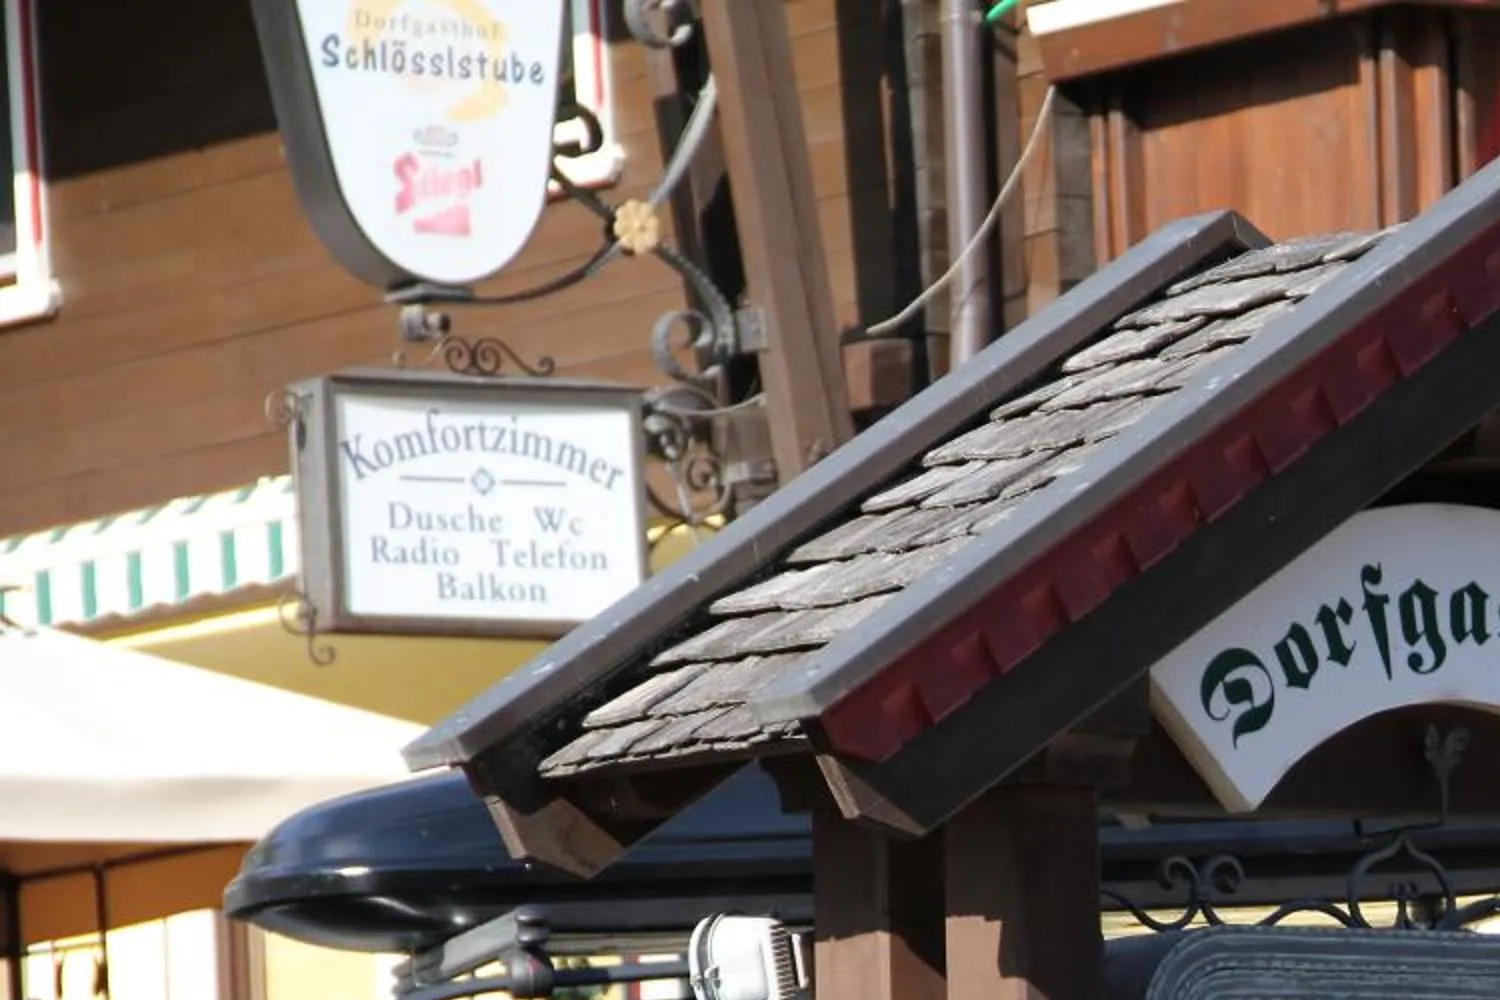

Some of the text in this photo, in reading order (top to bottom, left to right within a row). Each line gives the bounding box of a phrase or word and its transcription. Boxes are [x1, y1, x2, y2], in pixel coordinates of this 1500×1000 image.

[321, 33, 547, 85] Schlösslstube
[340, 407, 624, 491] Komfortzimmer
[388, 500, 504, 534] Dusche
[370, 535, 608, 571] Radio Telefon
[436, 572, 548, 602] Balkon
